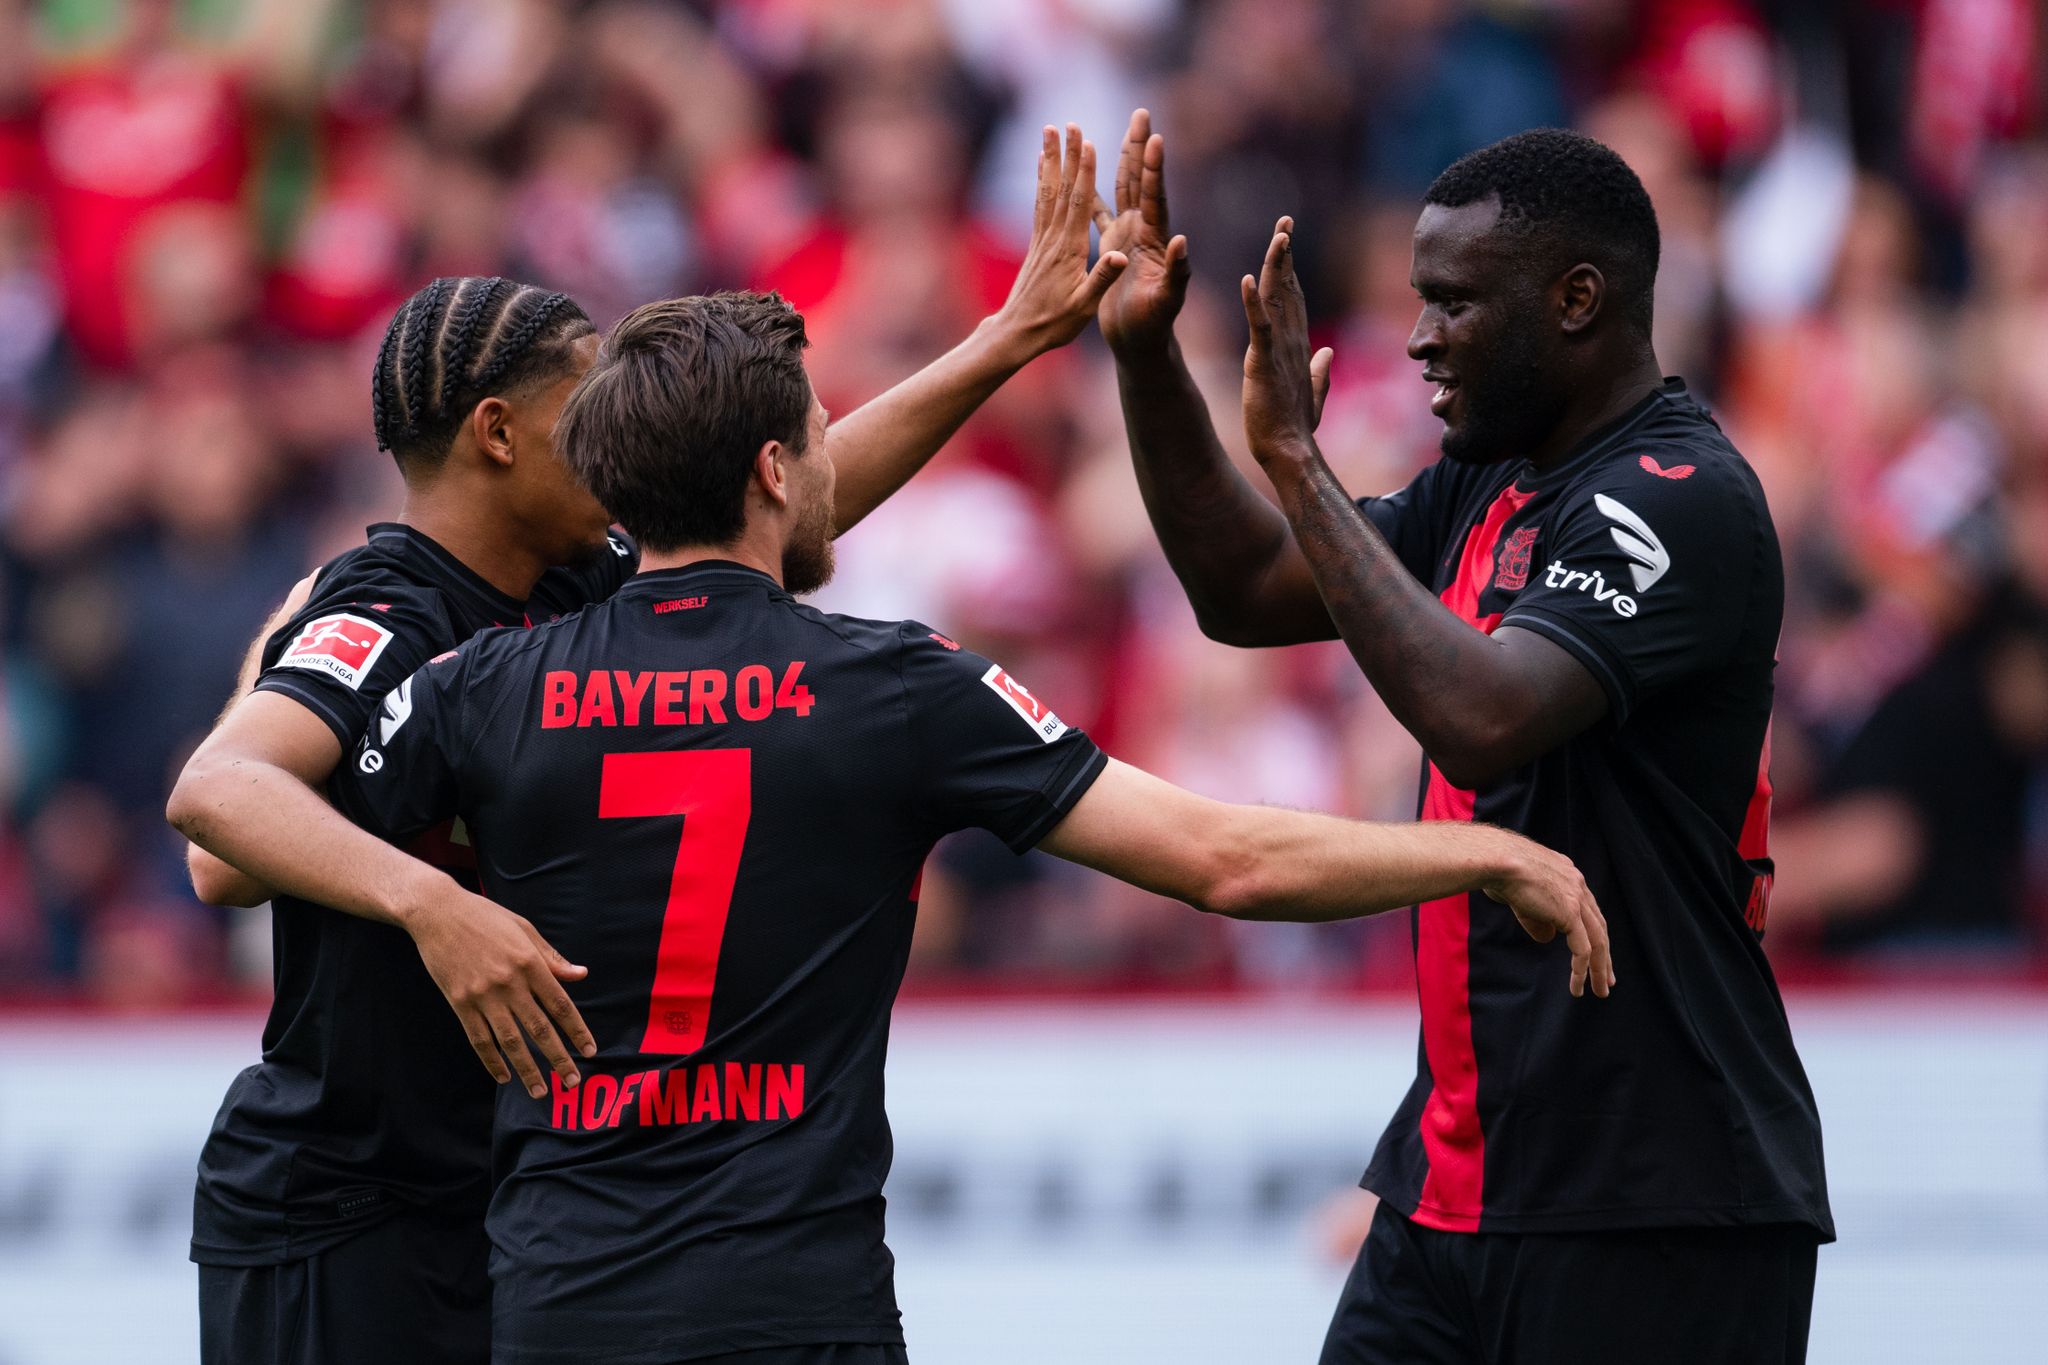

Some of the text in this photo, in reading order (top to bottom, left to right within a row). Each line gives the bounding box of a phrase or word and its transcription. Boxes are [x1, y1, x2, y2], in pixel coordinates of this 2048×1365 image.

[653, 596, 709, 614] WERKSELF
[1545, 560, 1638, 618] trive
[541, 661, 815, 728] BAYER 04
[598, 748, 751, 1055] 7
[551, 1062, 804, 1130] HOFMANN
